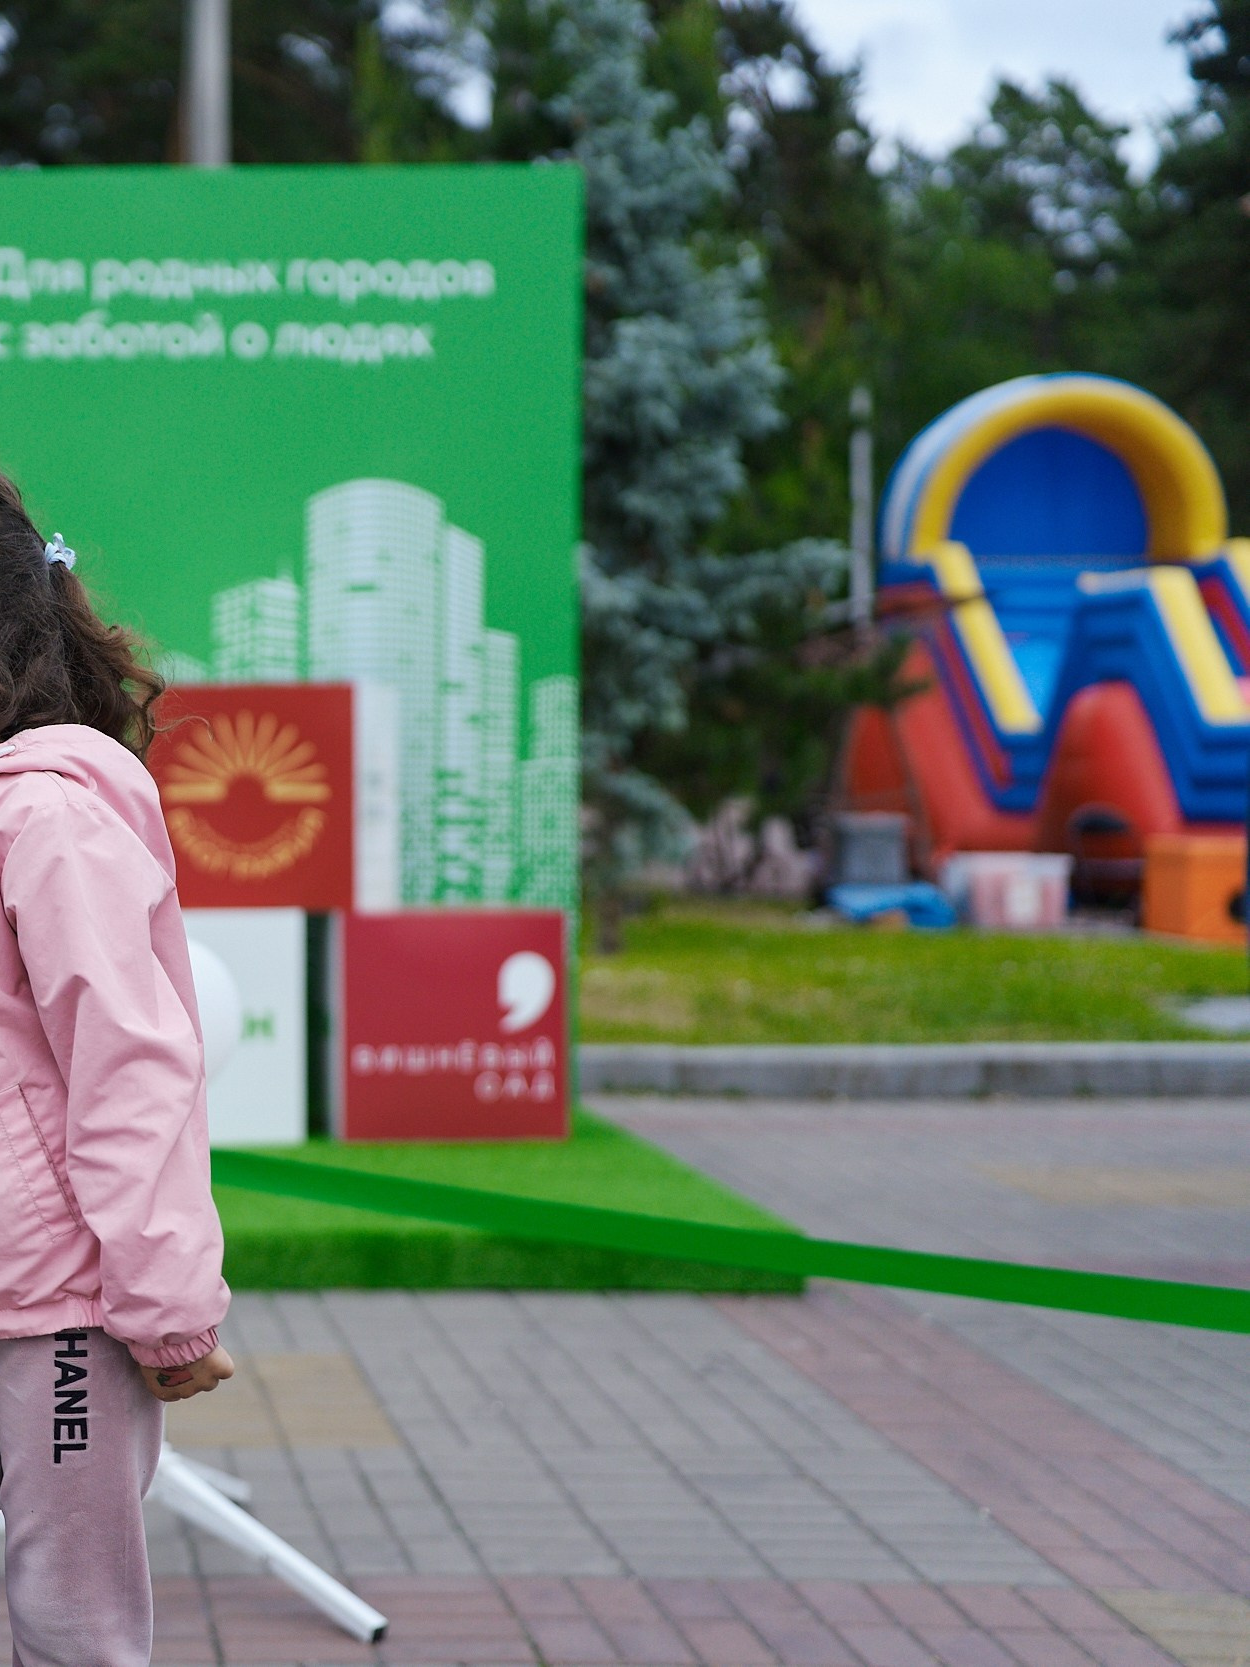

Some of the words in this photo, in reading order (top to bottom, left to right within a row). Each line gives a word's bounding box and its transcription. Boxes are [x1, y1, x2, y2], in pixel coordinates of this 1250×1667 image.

[91, 258, 280, 304] родных
[286, 258, 495, 305] городов
[18, 309, 225, 361] заботой
[230, 321, 268, 361] о
[274, 321, 435, 365] людях
[474, 1070, 556, 1102] САД
